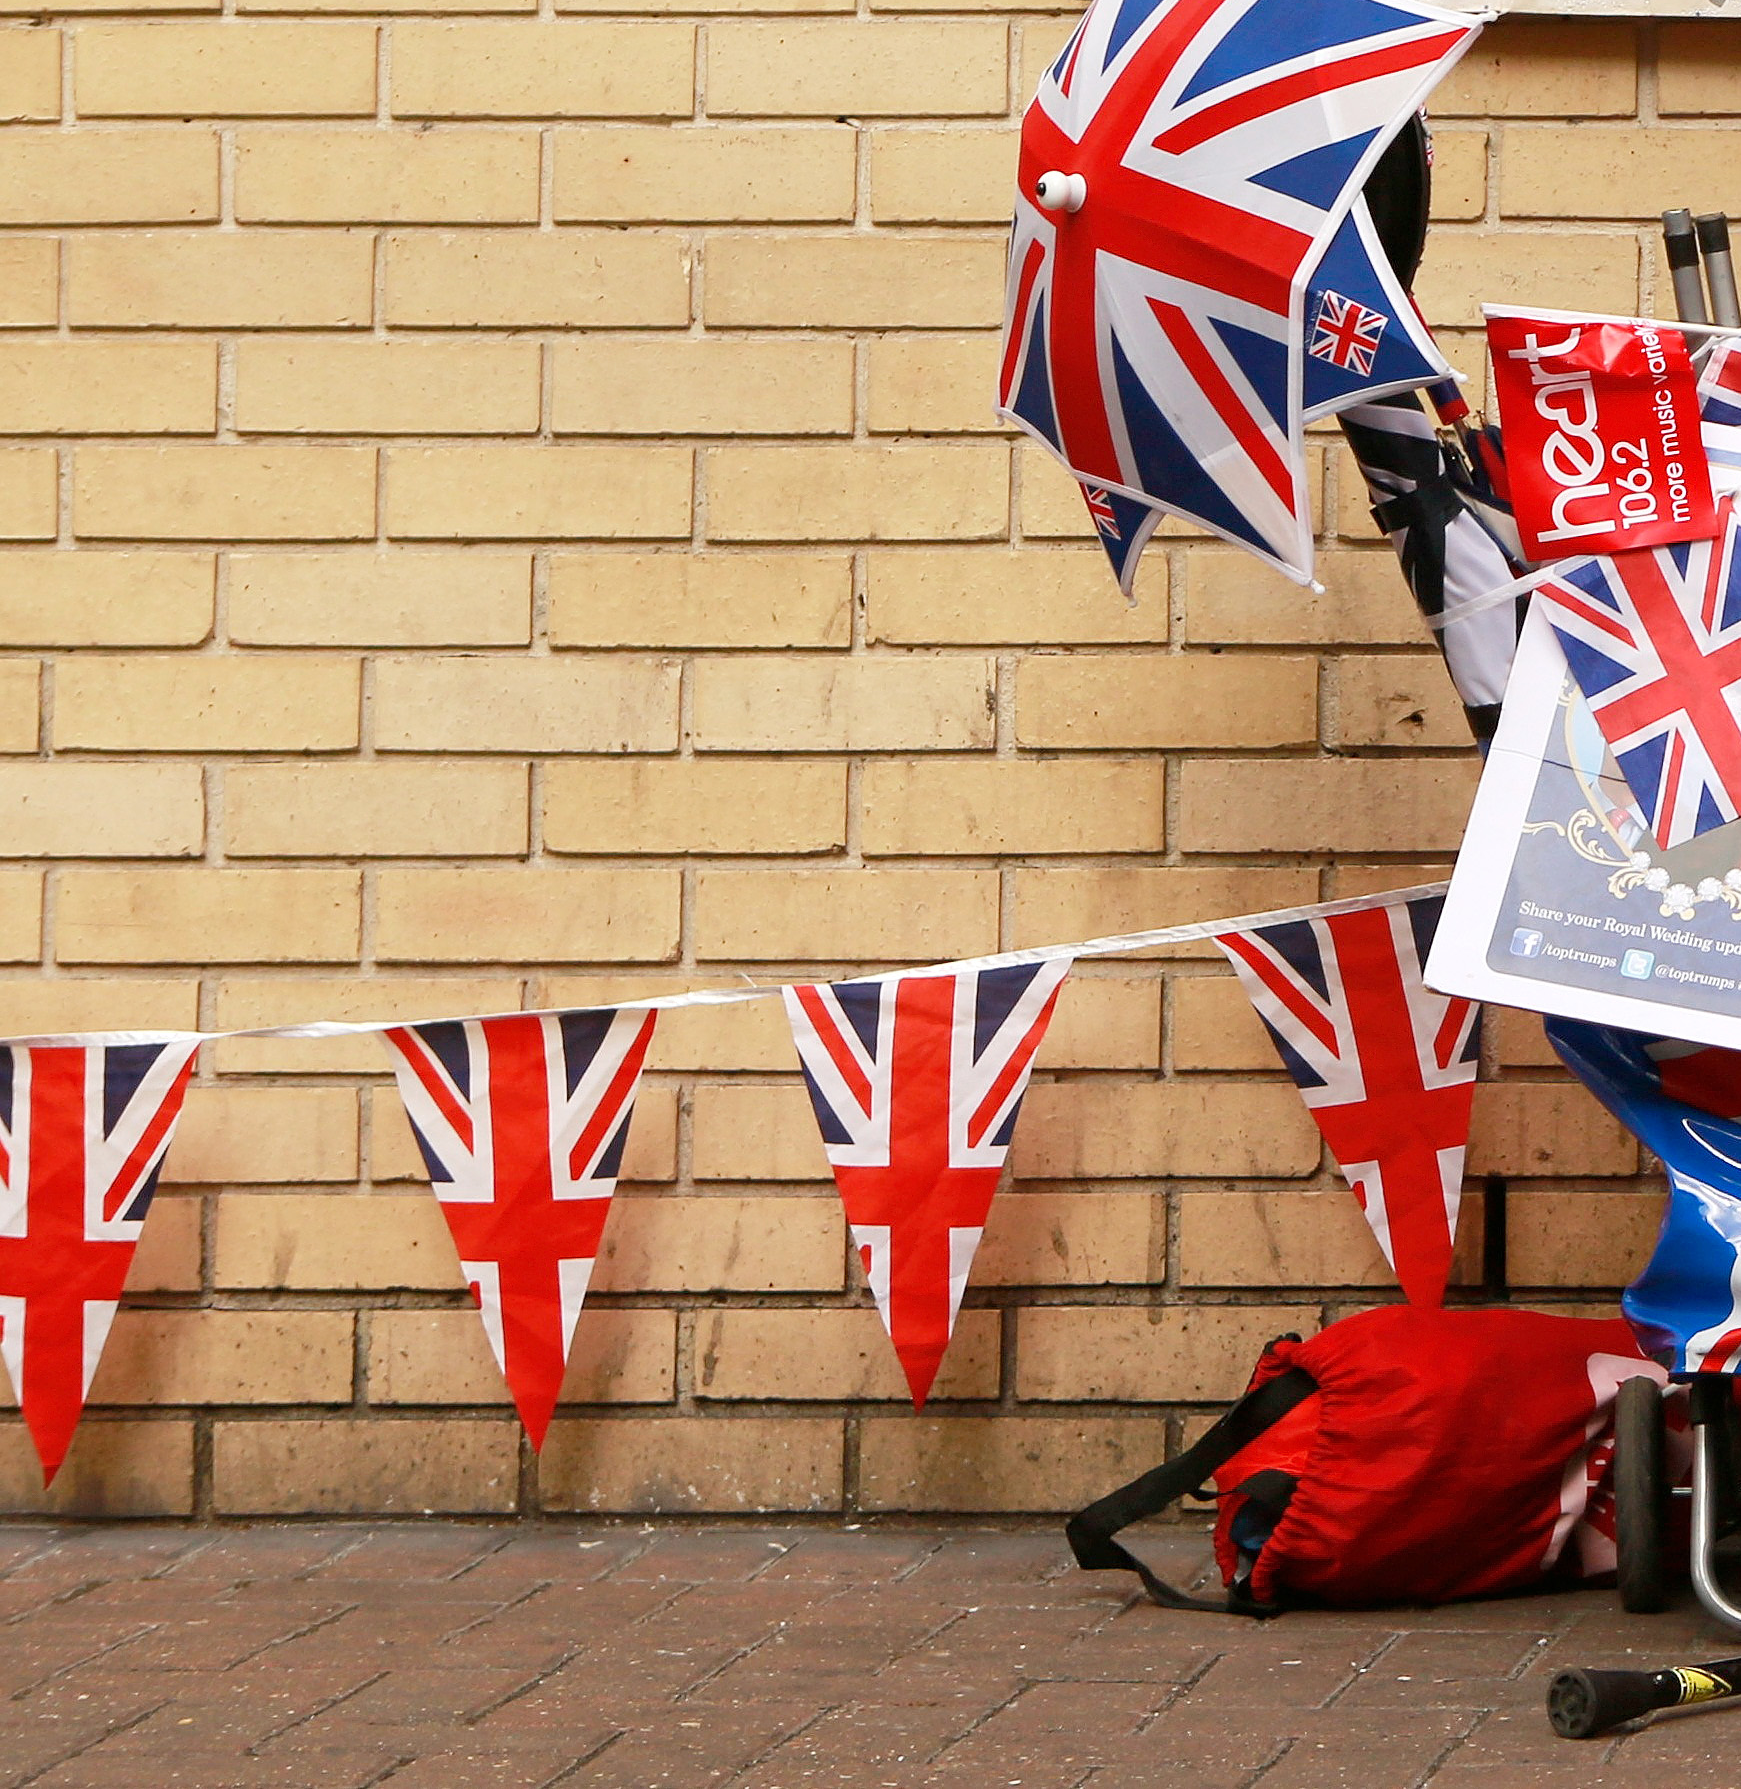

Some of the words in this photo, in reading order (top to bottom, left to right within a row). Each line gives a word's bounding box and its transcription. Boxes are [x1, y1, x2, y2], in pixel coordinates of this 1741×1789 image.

[1507, 327, 1616, 543] heart
[1653, 389, 1680, 456] music
[1611, 438, 1658, 529] 106.2
[1666, 462, 1691, 523] more
[1518, 901, 1564, 922] Share
[1564, 910, 1602, 931] your
[1603, 918, 1647, 939] Royal
[1649, 924, 1712, 953] Wedding
[1541, 941, 1618, 968] /toptrumps
[1654, 965, 1735, 991] @toptrumps
